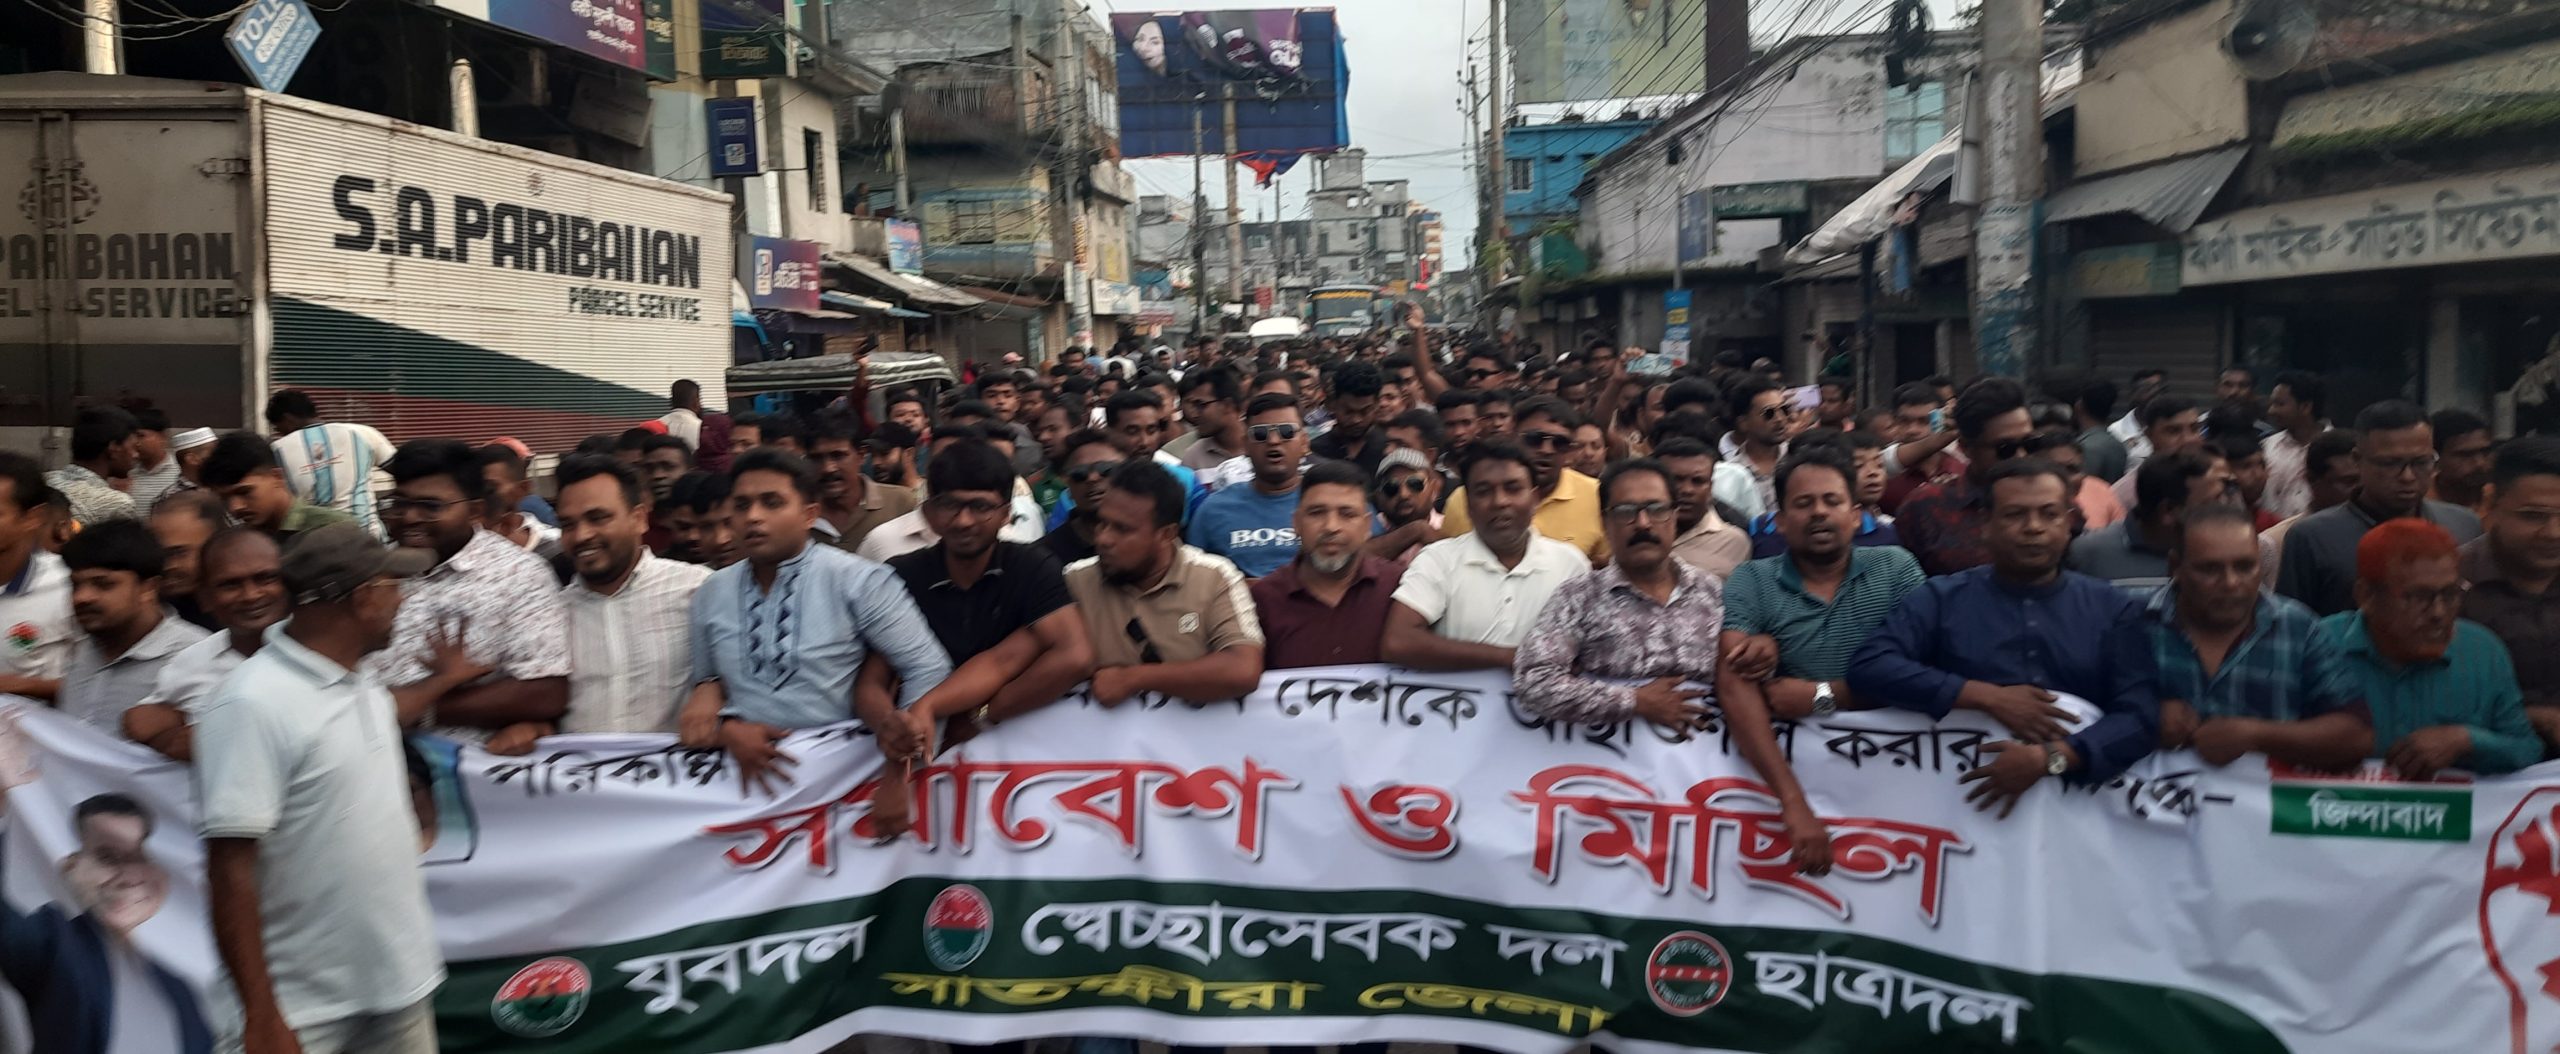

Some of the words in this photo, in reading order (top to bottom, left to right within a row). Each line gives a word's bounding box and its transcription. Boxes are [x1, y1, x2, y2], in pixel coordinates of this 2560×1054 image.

[0, 232, 232, 279] ARIBAHAN
[85, 287, 236, 318] SERVICE
[568, 286, 635, 318] PARCEL
[639, 292, 700, 322] SERVICE
[1229, 527, 1302, 545] BOS
[1276, 674, 1485, 730] দেশকে
[2307, 788, 2449, 836] জিন্দাবাদ
[1338, 782, 1461, 860] ও
[1509, 763, 1975, 927] মিছিল
[616, 915, 878, 1015] যুবদল
[1021, 901, 1467, 966] স্বেচ্ছাসেবক
[1484, 922, 1628, 990] দল
[1745, 949, 2034, 1045] ছাত্রদল
[1357, 981, 1615, 1034] জেলা
